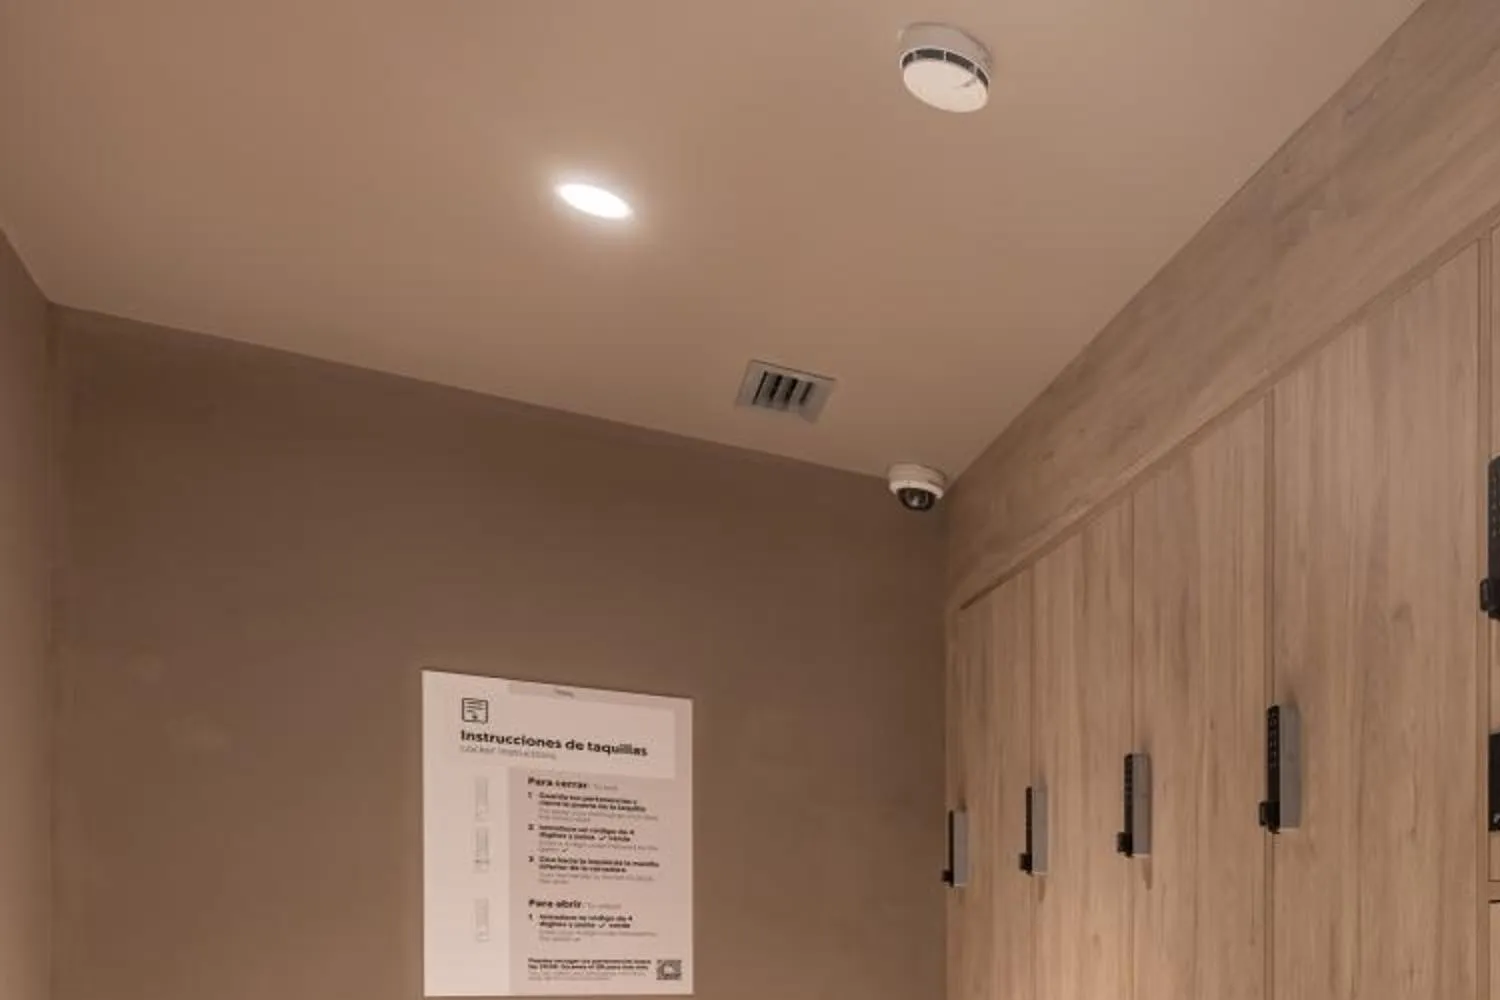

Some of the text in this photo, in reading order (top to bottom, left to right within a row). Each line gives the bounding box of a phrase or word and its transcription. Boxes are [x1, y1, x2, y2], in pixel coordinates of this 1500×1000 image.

[460, 729, 649, 757] Instrucciones de taquillas
[527, 776, 553, 788] Para
[555, 780, 587, 790] cerrar
[528, 898, 553, 909] Para
[555, 899, 582, 909] abrir
